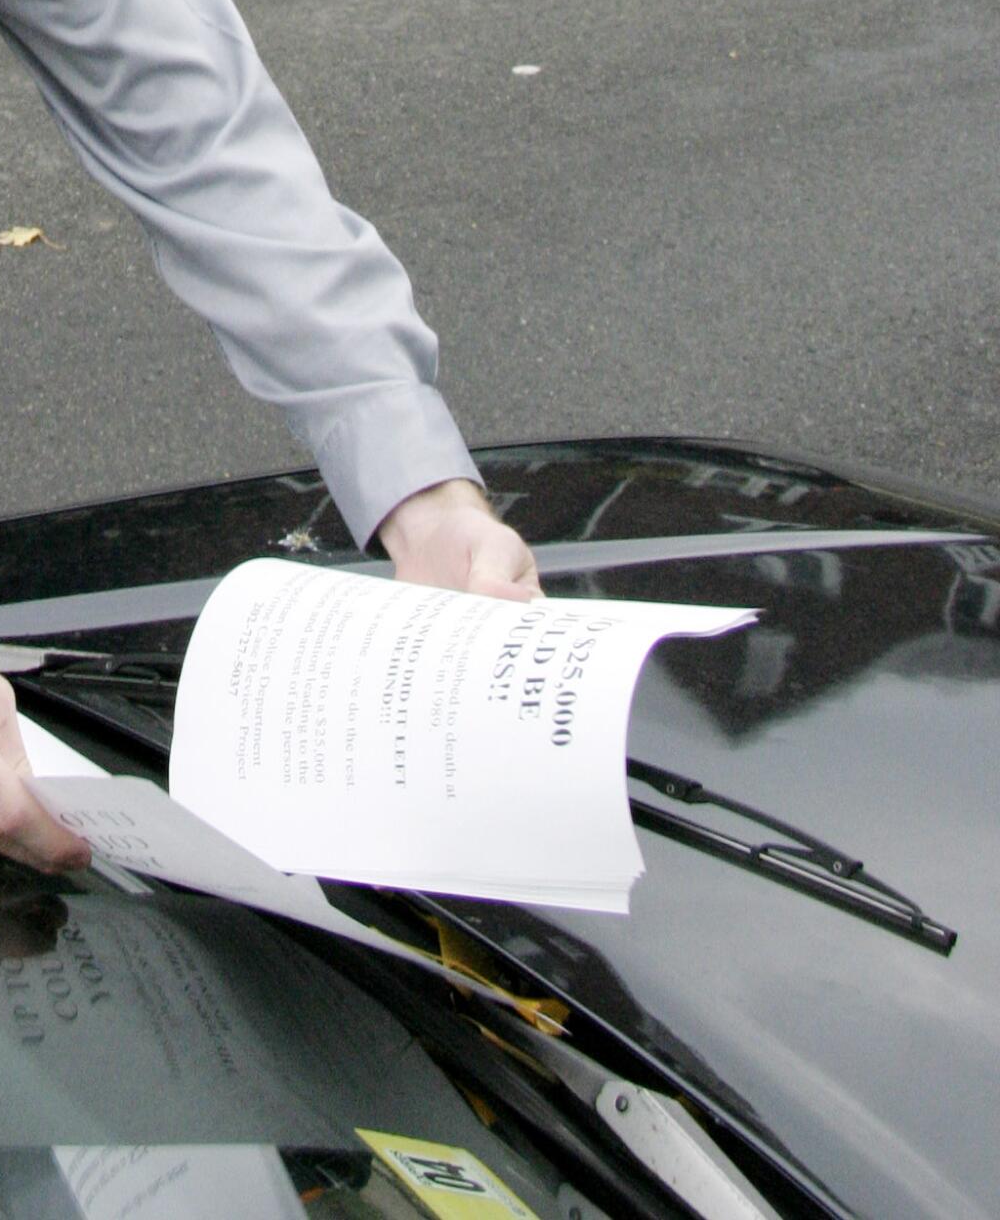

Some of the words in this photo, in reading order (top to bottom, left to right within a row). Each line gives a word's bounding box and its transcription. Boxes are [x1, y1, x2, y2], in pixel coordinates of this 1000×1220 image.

[262, 628, 285, 671] Police
[319, 661, 333, 680] up
[435, 668, 450, 683] in
[448, 650, 471, 706] stabbed
[239, 663, 259, 719] Review
[319, 684, 331, 699] to
[399, 669, 416, 703] DID
[517, 677, 546, 721] BE
[549, 638, 598, 748] $25,000
[284, 701, 297, 725] the
[297, 676, 318, 734] leading
[316, 704, 325, 713] a
[347, 702, 360, 722] do
[396, 708, 409, 728] IT
[445, 710, 460, 727] to
[252, 675, 272, 768] Department
[235, 725, 250, 781] Project
[298, 739, 311, 756] to
[313, 717, 330, 785] $25,000
[345, 727, 359, 752] the
[394, 735, 407, 788] LEFT
[444, 732, 459, 779] death
[298, 760, 310, 785] the
[445, 783, 458, 800] at
